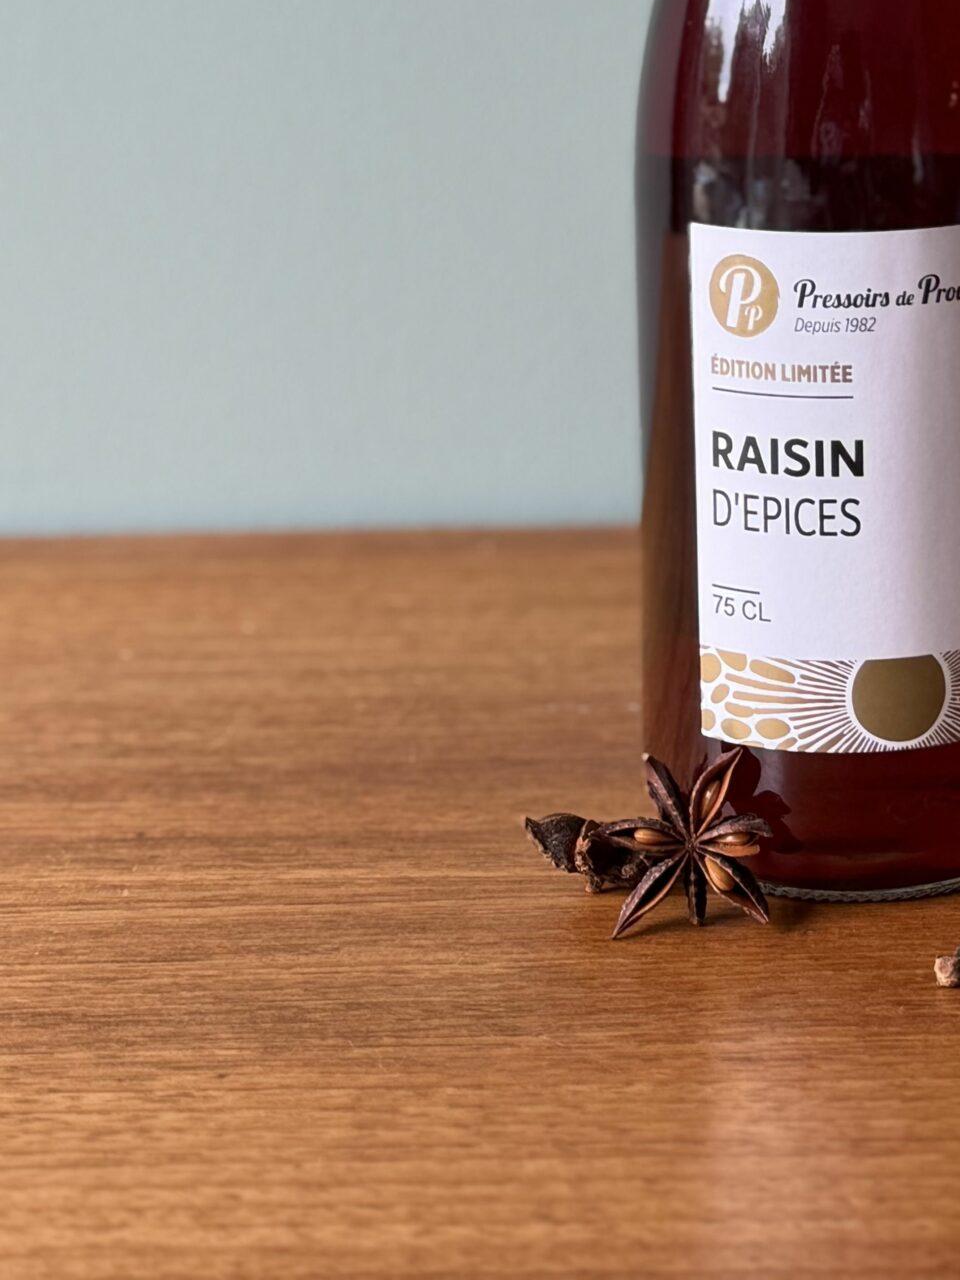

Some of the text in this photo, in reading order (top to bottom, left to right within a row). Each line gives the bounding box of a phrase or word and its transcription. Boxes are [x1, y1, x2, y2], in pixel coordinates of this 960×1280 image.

[793, 278, 890, 309] Pressoirs
[895, 290, 915, 306] de
[794, 316, 877, 335] Depuis 1982
[711, 353, 853, 383] ÉDITION LIMITÉE
[712, 430, 864, 478] RAISIN
[712, 488, 861, 537] D'EPICES
[712, 594, 771, 622] 75 CL
